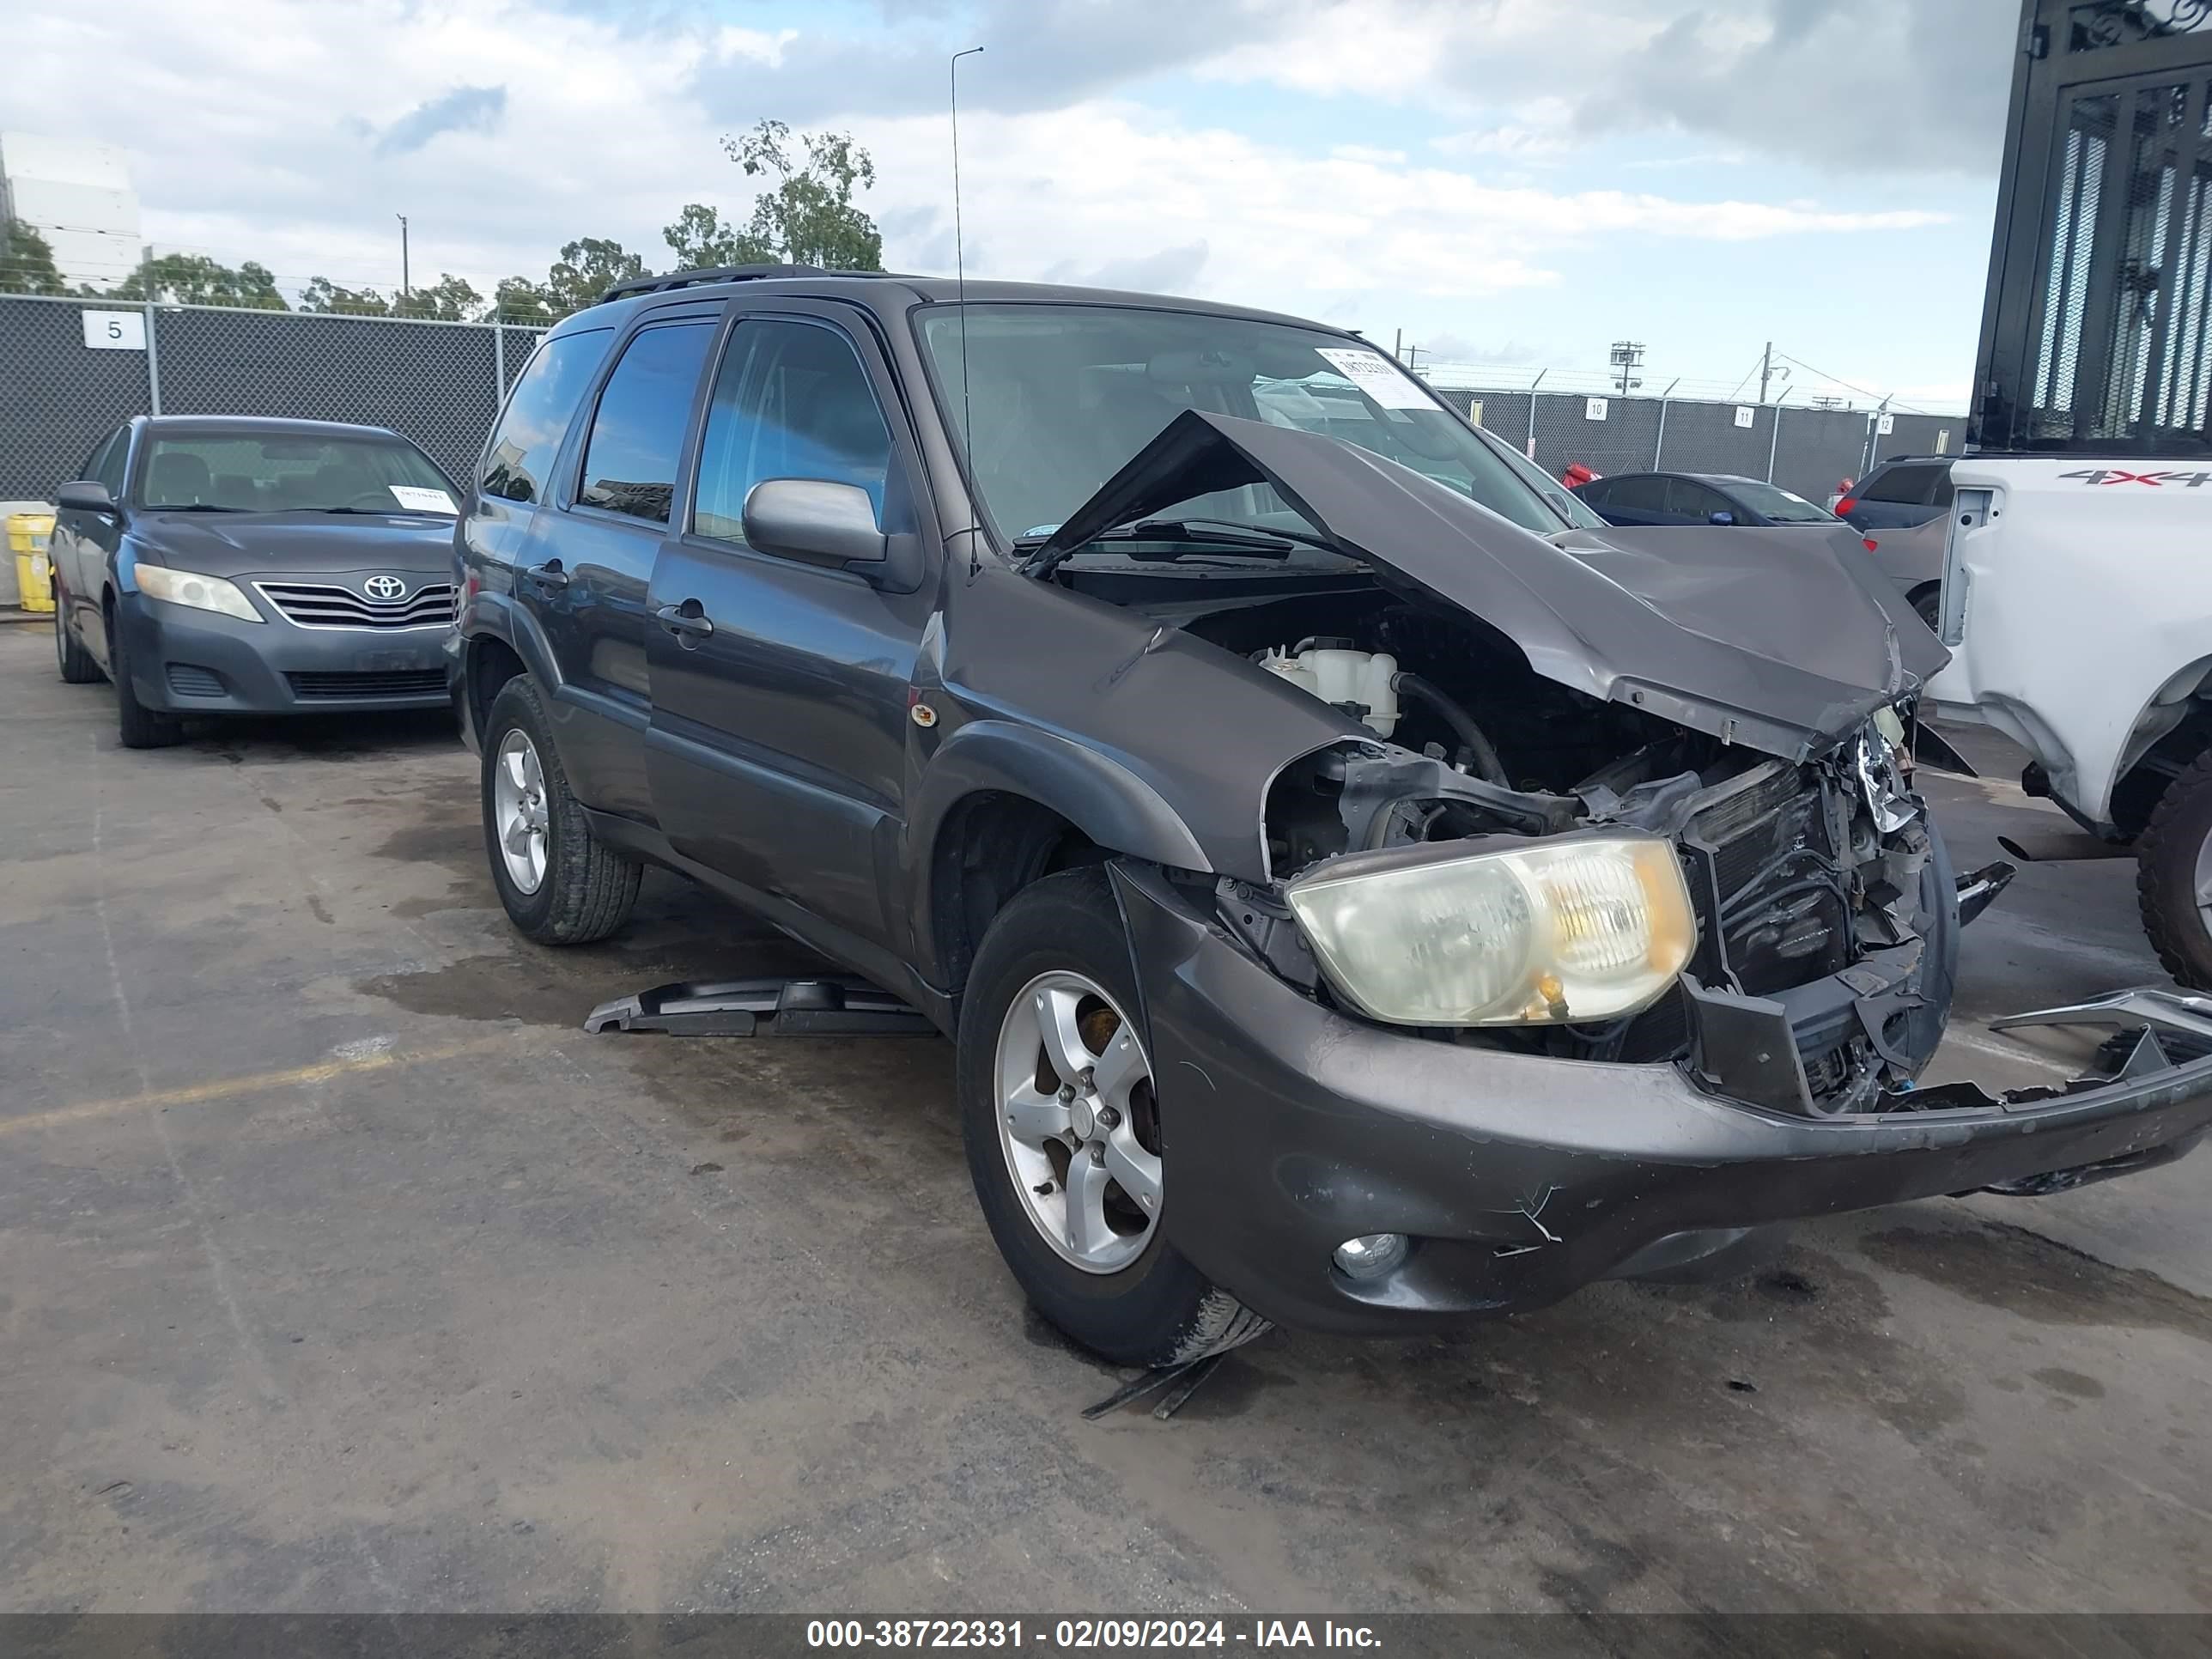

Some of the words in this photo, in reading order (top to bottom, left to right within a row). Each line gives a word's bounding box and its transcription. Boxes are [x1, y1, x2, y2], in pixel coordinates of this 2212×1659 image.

[108, 321, 122, 339] 5
[1592, 404, 1602, 415] 10
[1741, 412, 1749, 422] 11
[1881, 420, 1889, 429] 12
